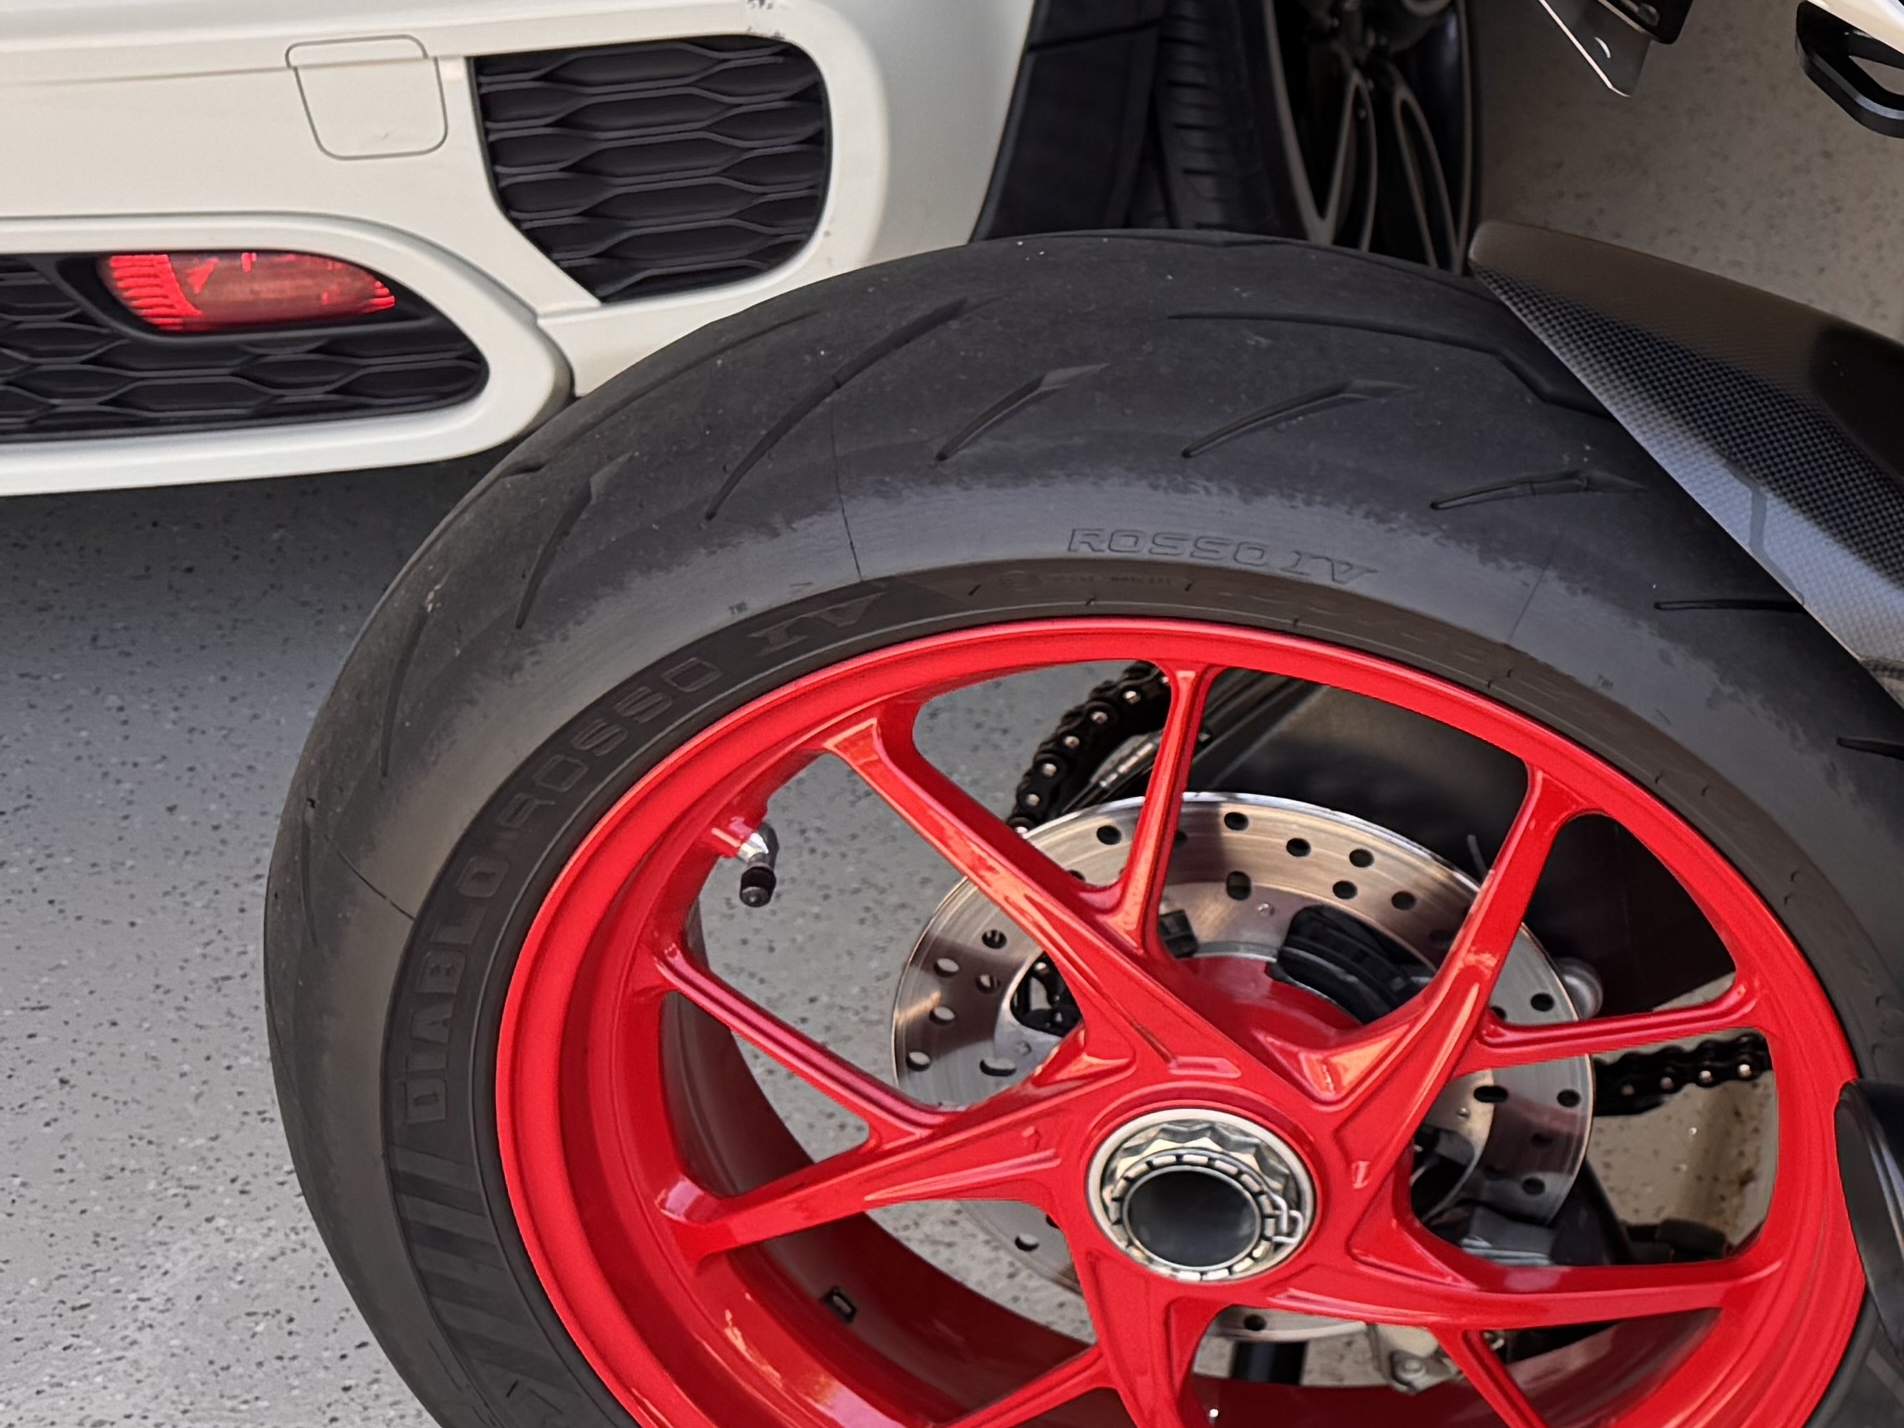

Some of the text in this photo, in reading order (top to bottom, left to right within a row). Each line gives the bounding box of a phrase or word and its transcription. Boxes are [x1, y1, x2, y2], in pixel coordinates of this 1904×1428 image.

[1066, 525, 1379, 585] ROSSO IV
[403, 853, 511, 1125] DIABLO
[501, 657, 720, 832] ROSSO
